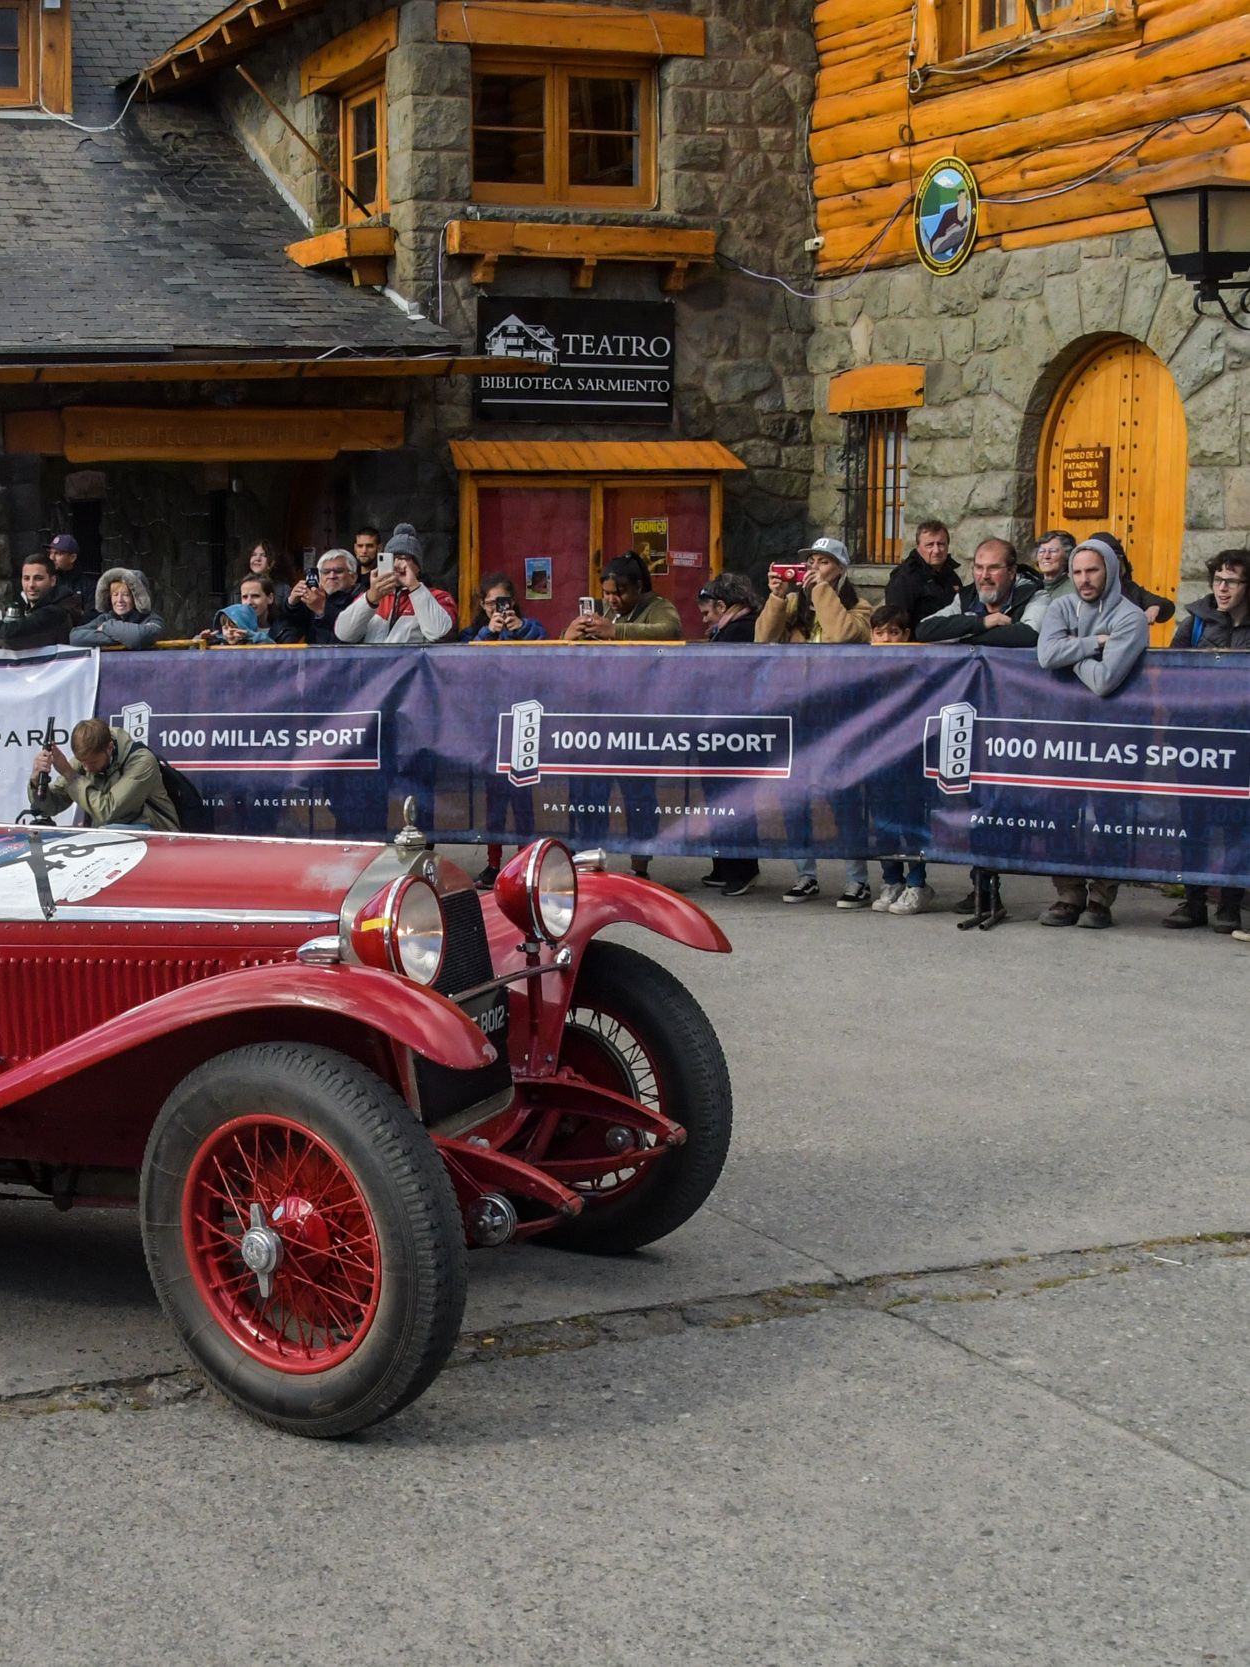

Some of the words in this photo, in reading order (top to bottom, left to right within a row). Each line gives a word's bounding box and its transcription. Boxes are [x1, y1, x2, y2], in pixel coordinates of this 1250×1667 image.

[561, 333, 671, 358] TEATRO
[480, 375, 573, 391] BIBLIOTECA
[577, 378, 670, 393] SARMIENTO
[1063, 451, 1085, 460] MUSEO
[1086, 451, 1094, 459] DE
[1095, 450, 1104, 458] LA
[1064, 461, 1099, 470] PATAGONIA
[1067, 470, 1087, 479] LUNES
[1088, 470, 1093, 478] A
[1071, 480, 1098, 488] VIERNES
[158, 730, 206, 747] 1000
[210, 729, 290, 747] MILLAS
[295, 727, 367, 746] SPORT
[522, 711, 535, 767] 1000
[550, 731, 601, 750] 1000
[606, 732, 691, 752] MILLAS
[697, 733, 777, 752] SPORT
[951, 714, 967, 776] 1000
[984, 737, 1037, 760] 1000
[1042, 739, 1139, 766] MILLAS
[1145, 745, 1236, 770] SPORT
[253, 798, 333, 807] ARGENTINA
[543, 803, 622, 814] PATAGONIA
[654, 806, 736, 816] ARGENTINA
[970, 814, 1057, 830] PATAGONIA
[1092, 824, 1188, 838] ARGENTINA
[481, 1005, 505, 1034] 8012
